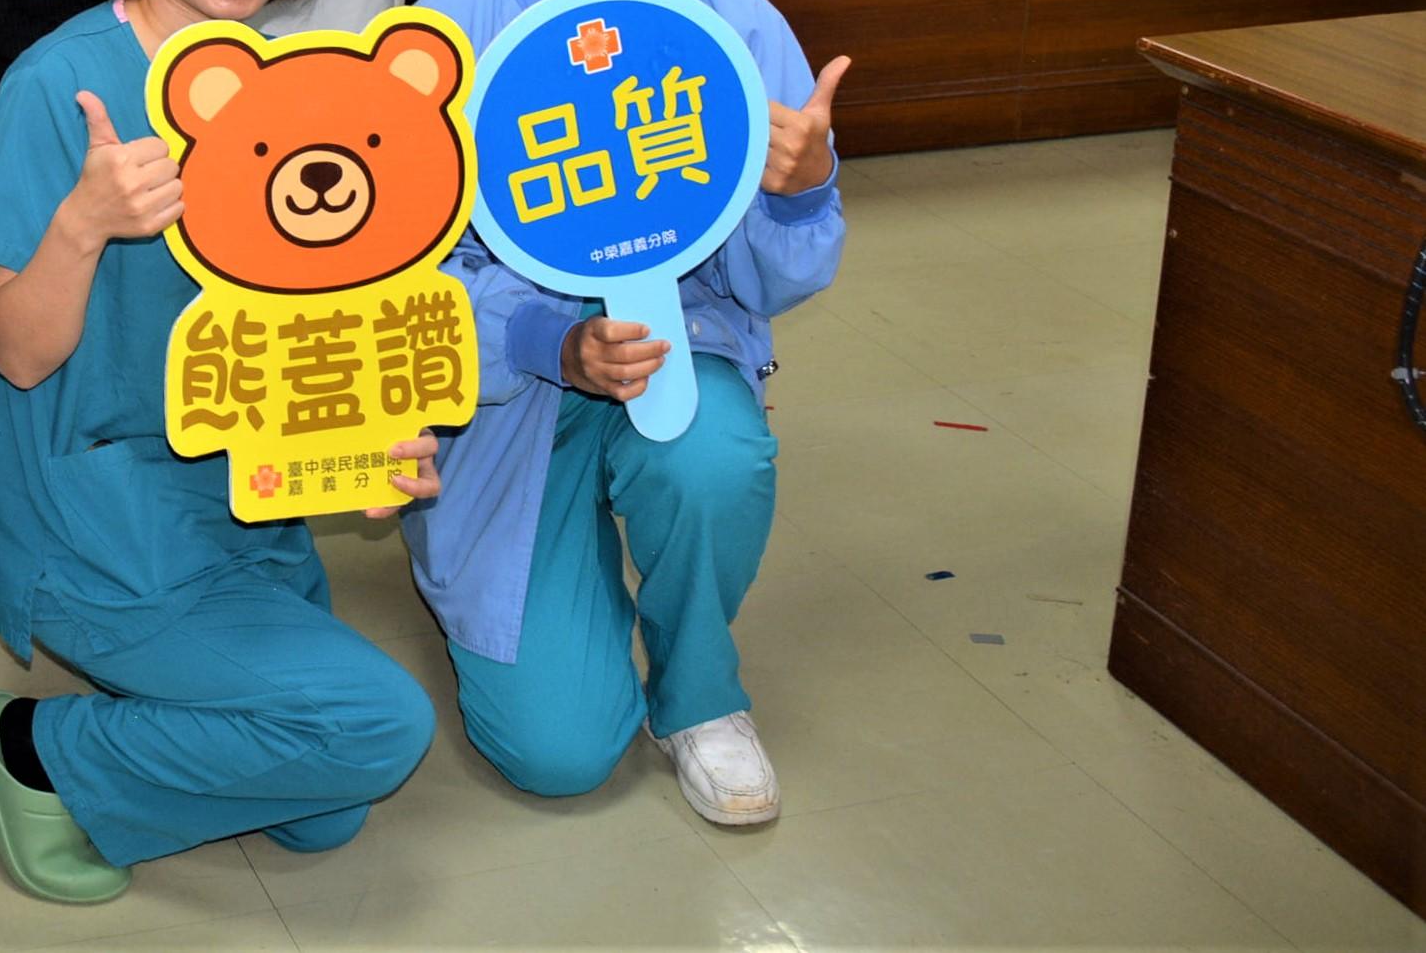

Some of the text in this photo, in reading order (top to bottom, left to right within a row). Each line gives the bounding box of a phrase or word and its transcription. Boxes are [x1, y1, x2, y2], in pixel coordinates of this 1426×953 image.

[508, 66, 710, 224] 品質
[590, 229, 678, 263] 中榮嘉義分院
[181, 290, 464, 436] 熊蓋讚
